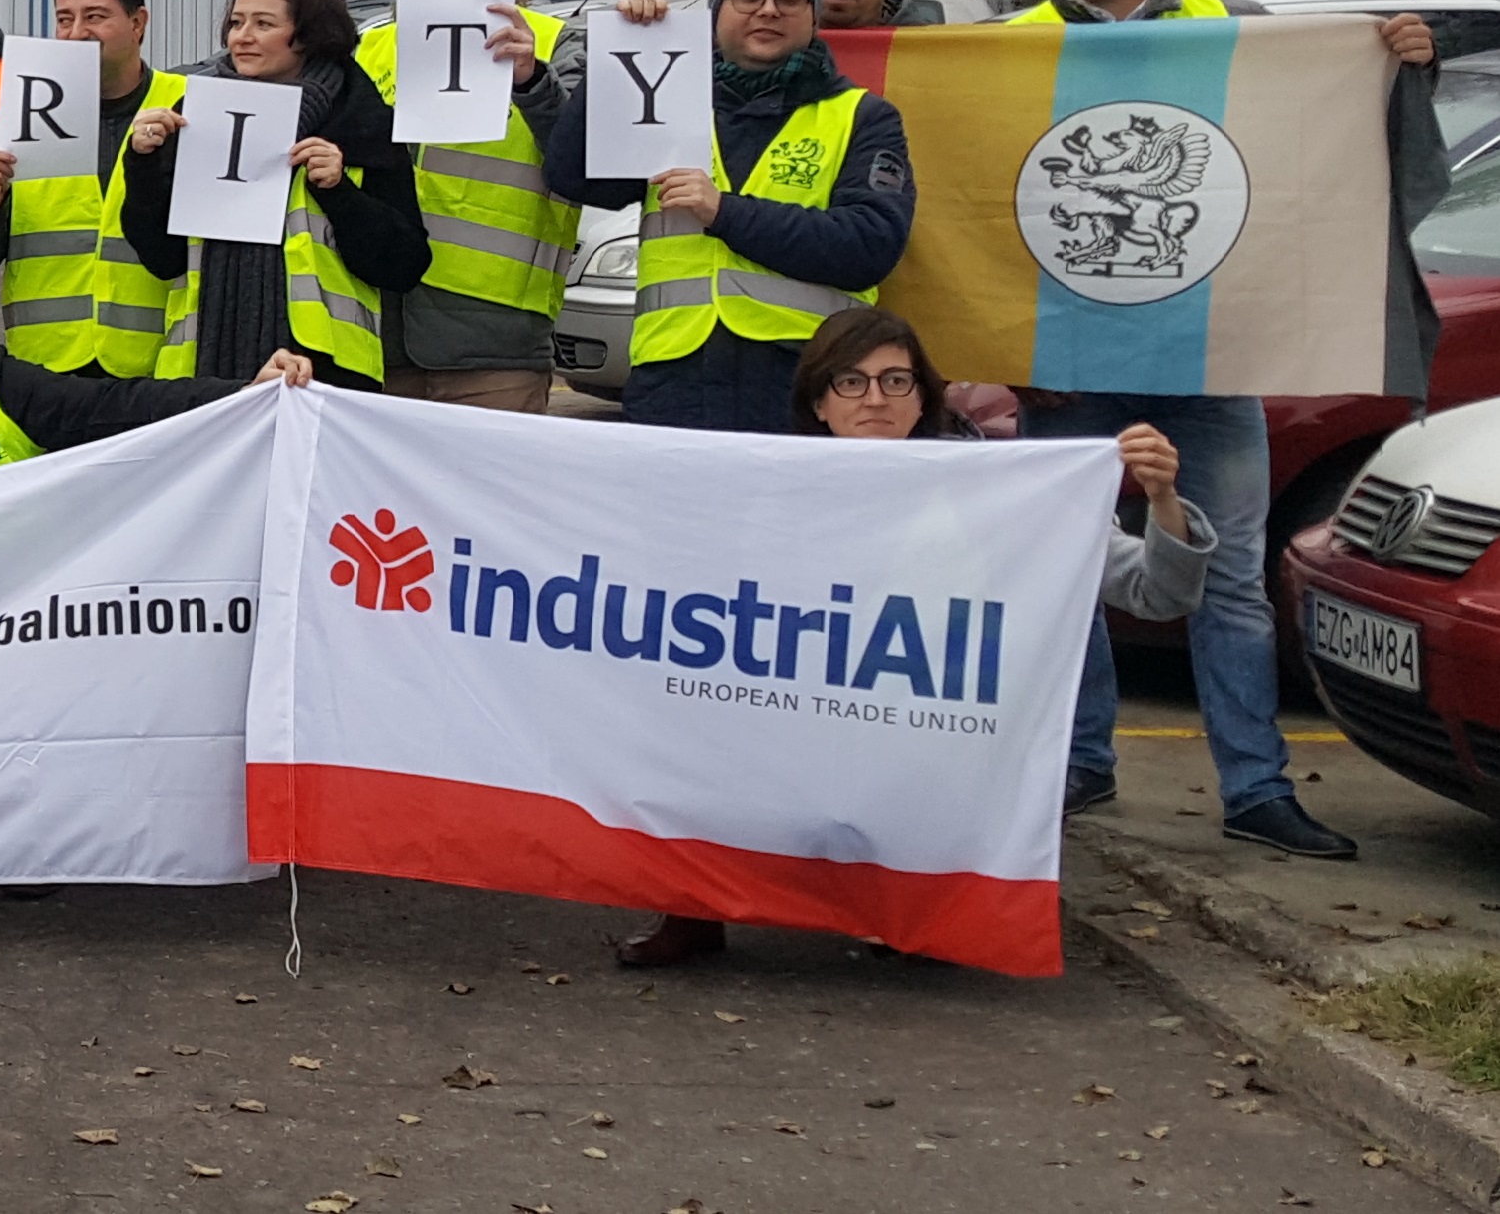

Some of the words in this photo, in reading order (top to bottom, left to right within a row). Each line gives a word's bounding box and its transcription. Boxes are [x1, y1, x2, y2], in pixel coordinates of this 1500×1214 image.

[10, 74, 78, 143] R
[215, 110, 257, 184] I
[425, 23, 488, 94] T
[608, 50, 689, 126] Y
[448, 537, 1005, 704] industriAll
[665, 676, 800, 712] EUROPEAN
[811, 696, 898, 726] TRADE
[908, 710, 999, 736] UNION
